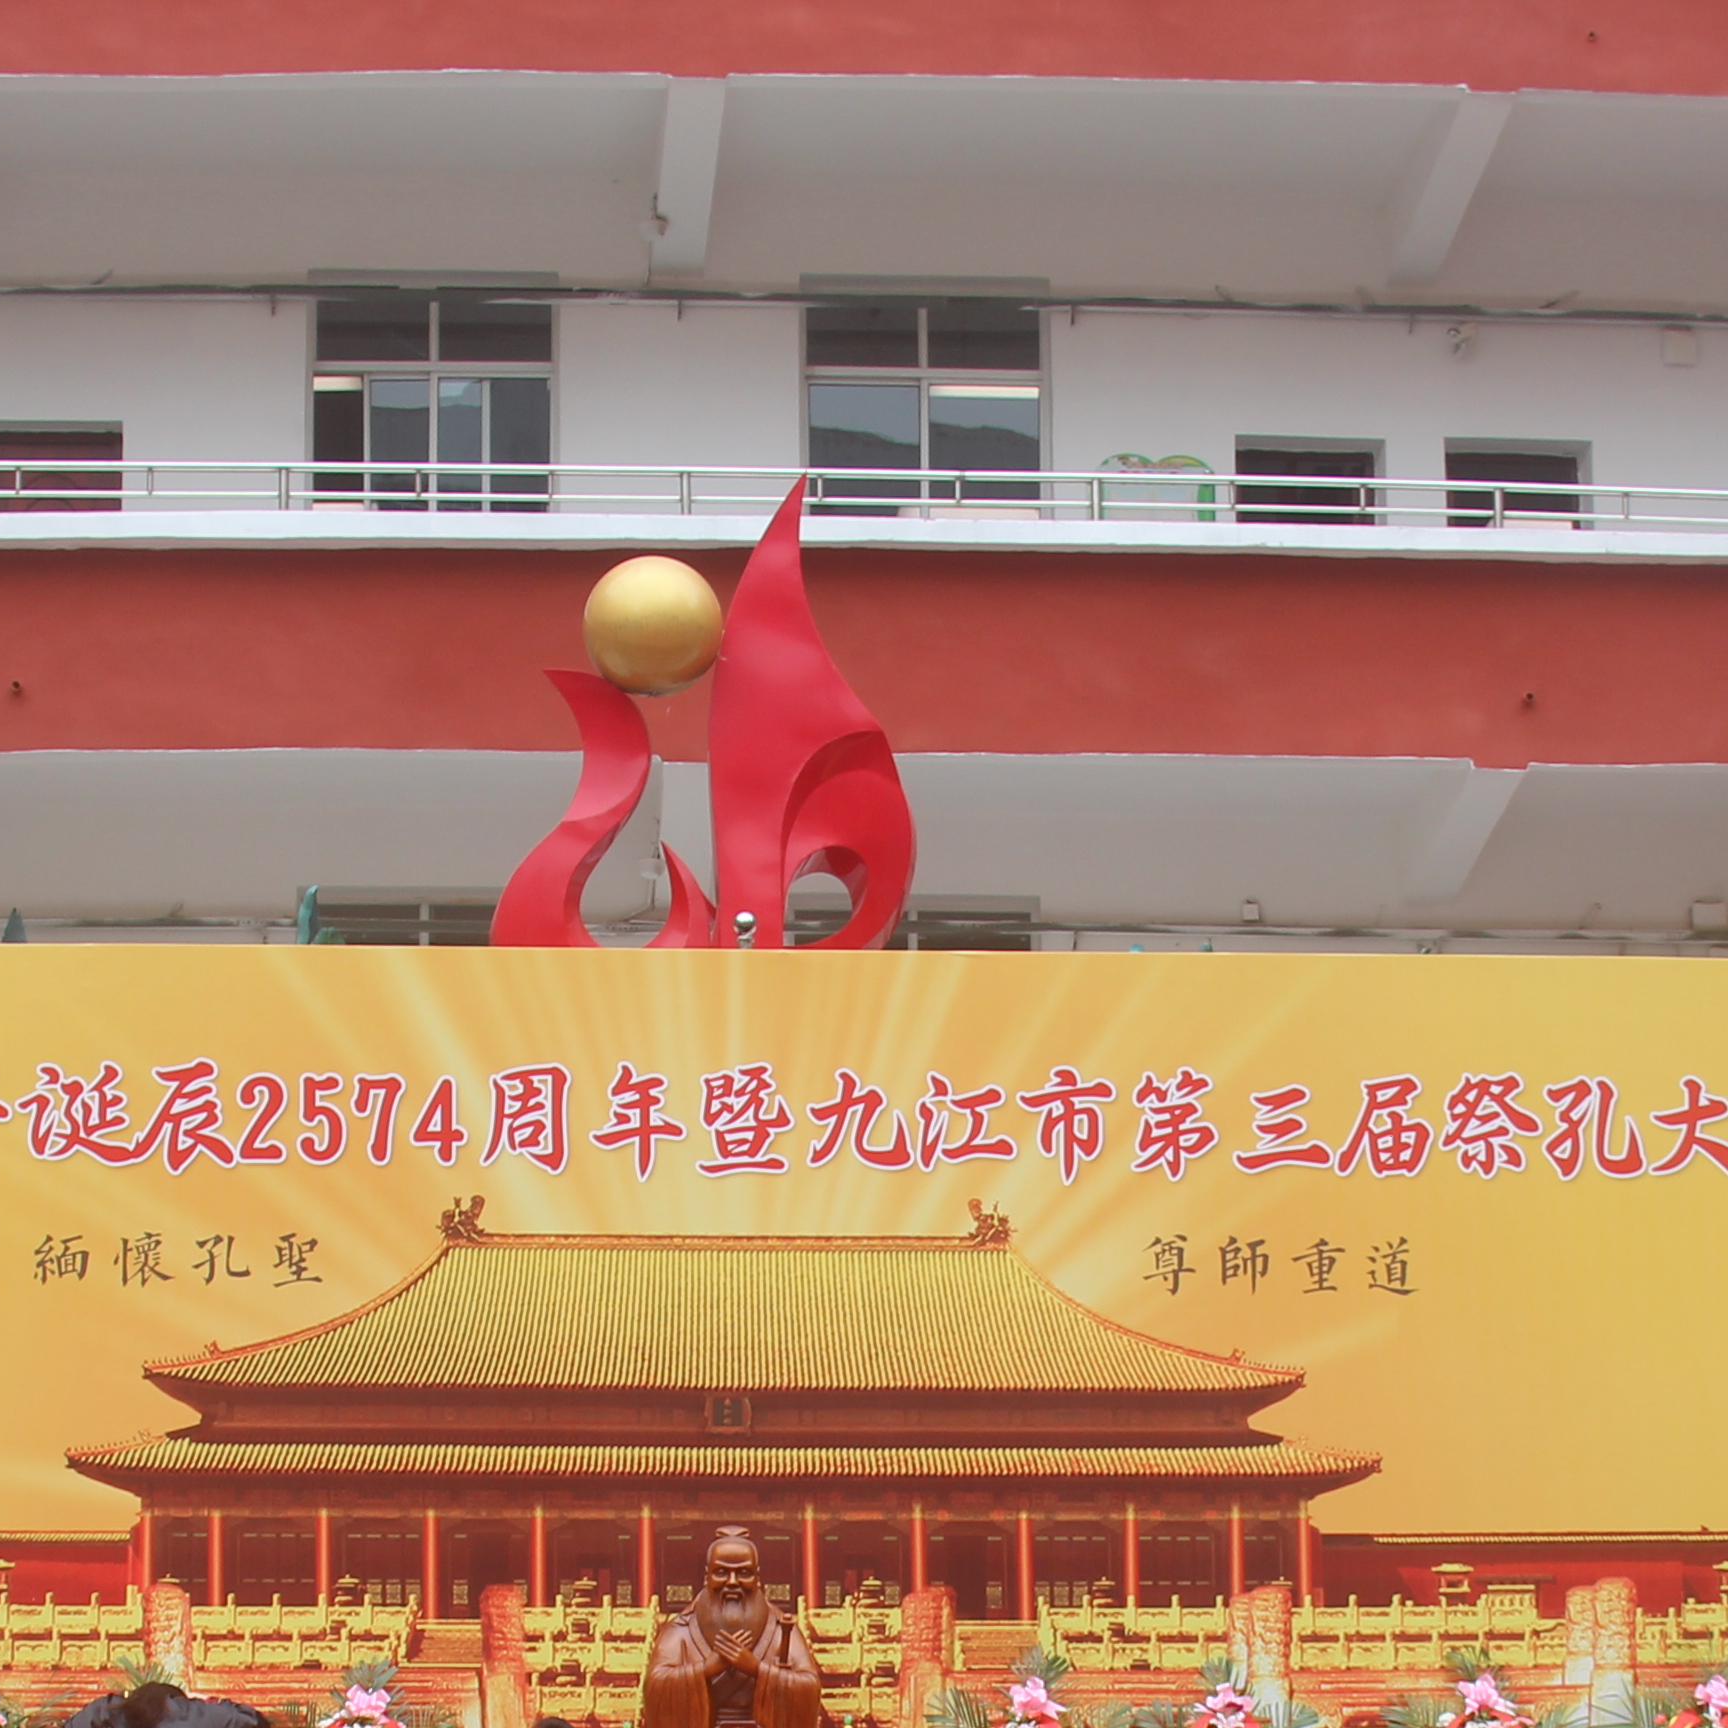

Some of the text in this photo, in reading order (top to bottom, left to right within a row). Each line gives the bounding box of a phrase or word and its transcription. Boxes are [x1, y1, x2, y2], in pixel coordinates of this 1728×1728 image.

[33, 1232, 325, 1290] 緬懷孔聖
[1142, 1234, 1419, 1298] 尊師重道
